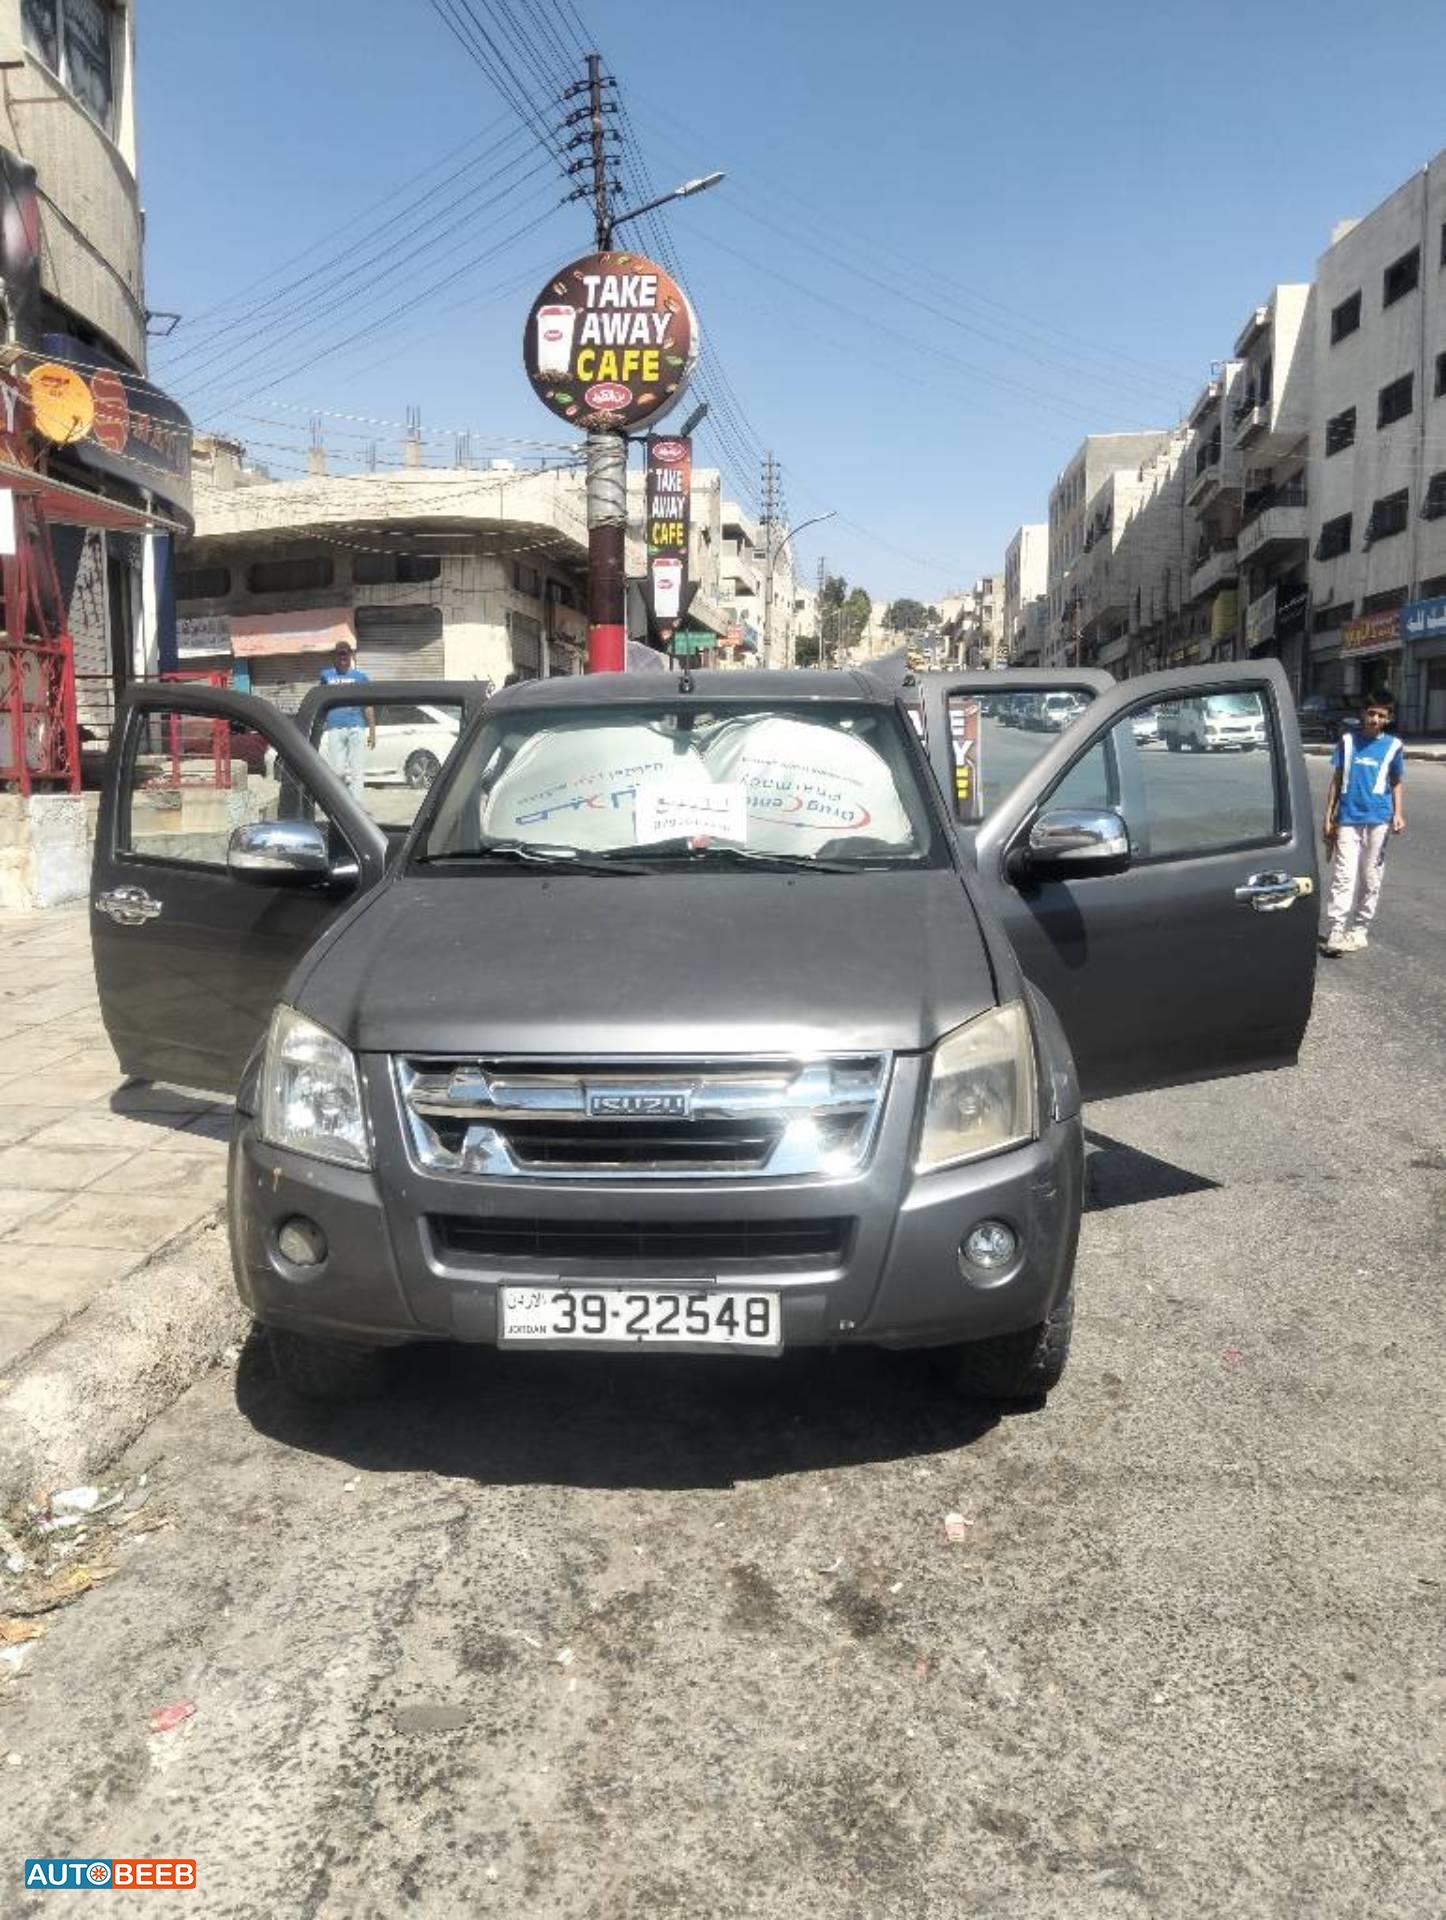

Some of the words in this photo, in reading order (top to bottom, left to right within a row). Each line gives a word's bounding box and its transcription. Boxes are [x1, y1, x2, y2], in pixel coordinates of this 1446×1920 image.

[583, 275, 658, 307] TAKE
[580, 312, 673, 346] AWAY
[576, 349, 660, 382] CAFE
[655, 468, 683, 492] TAKE
[652, 494, 686, 519] AWAY
[652, 522, 684, 545] CAFE
[805, 801, 855, 823] Drug
[593, 1096, 683, 1114] ISUZU
[550, 1293, 771, 1337] 39-22548
[507, 1324, 547, 1335] JORDAN
